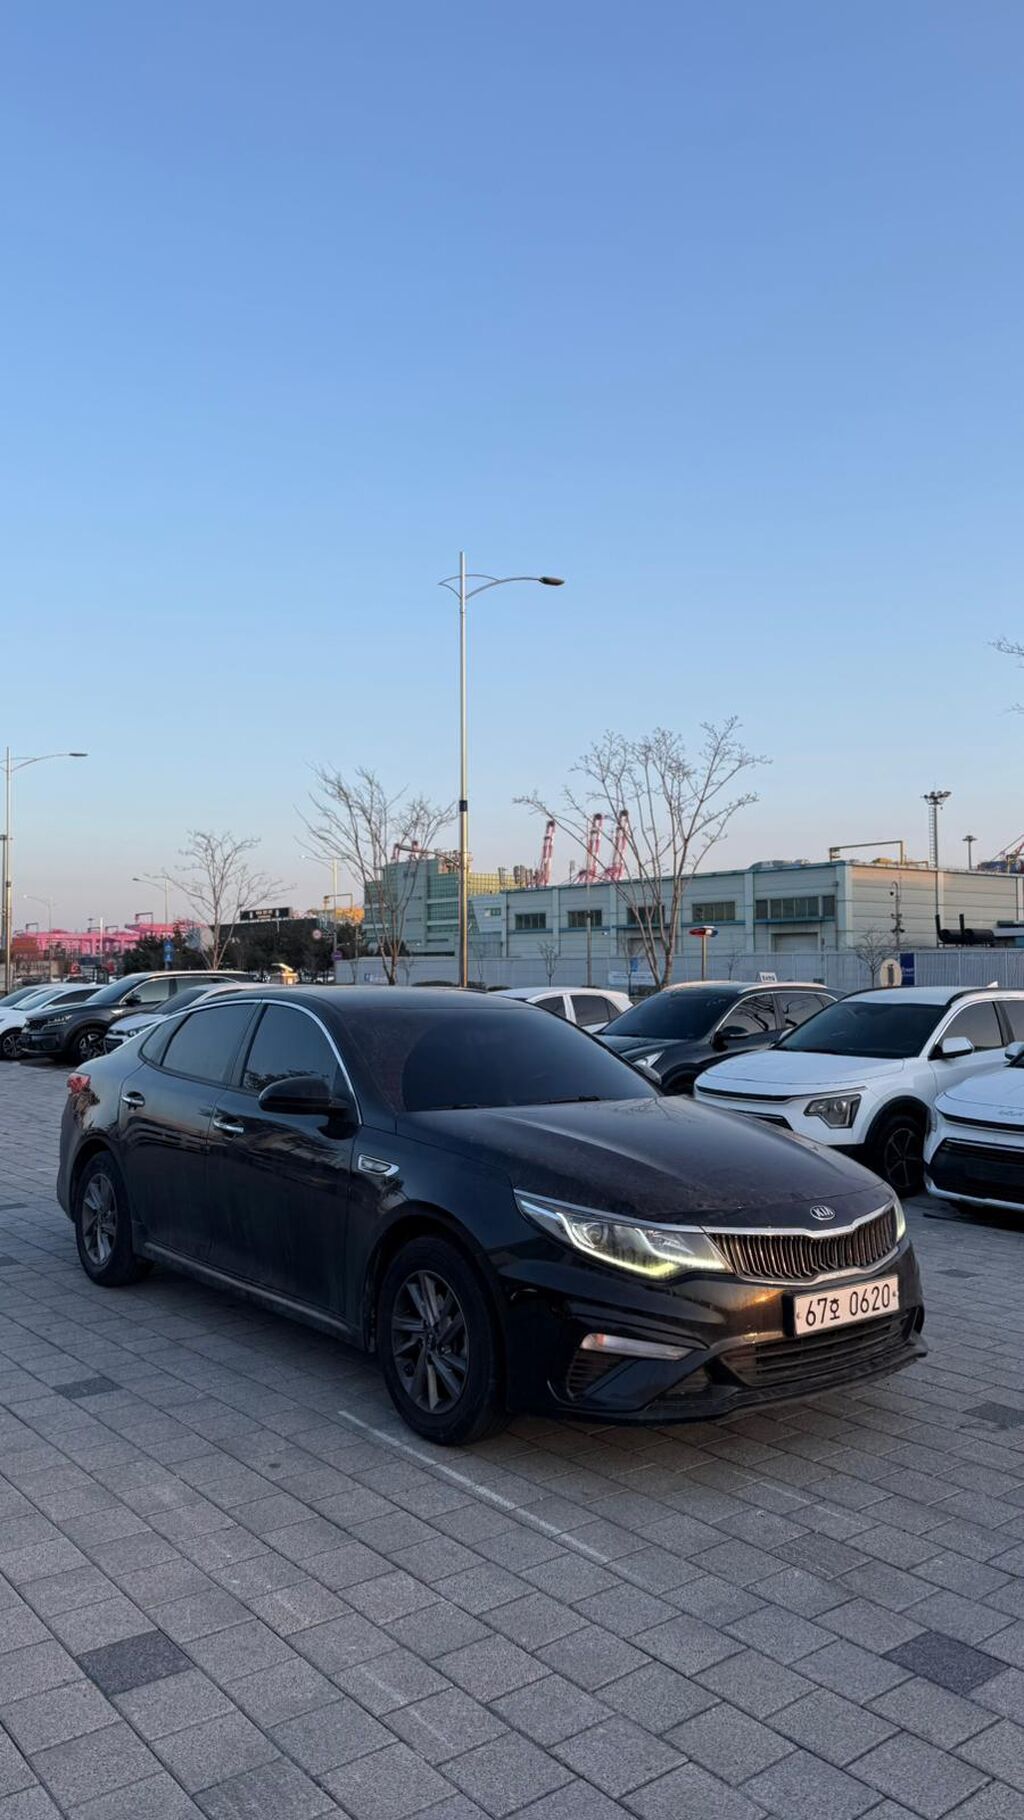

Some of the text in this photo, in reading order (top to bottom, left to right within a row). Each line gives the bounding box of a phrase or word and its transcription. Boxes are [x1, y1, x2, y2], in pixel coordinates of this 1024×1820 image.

[812, 1206, 834, 1217] KIA
[805, 1283, 890, 1326] 67호 0620
